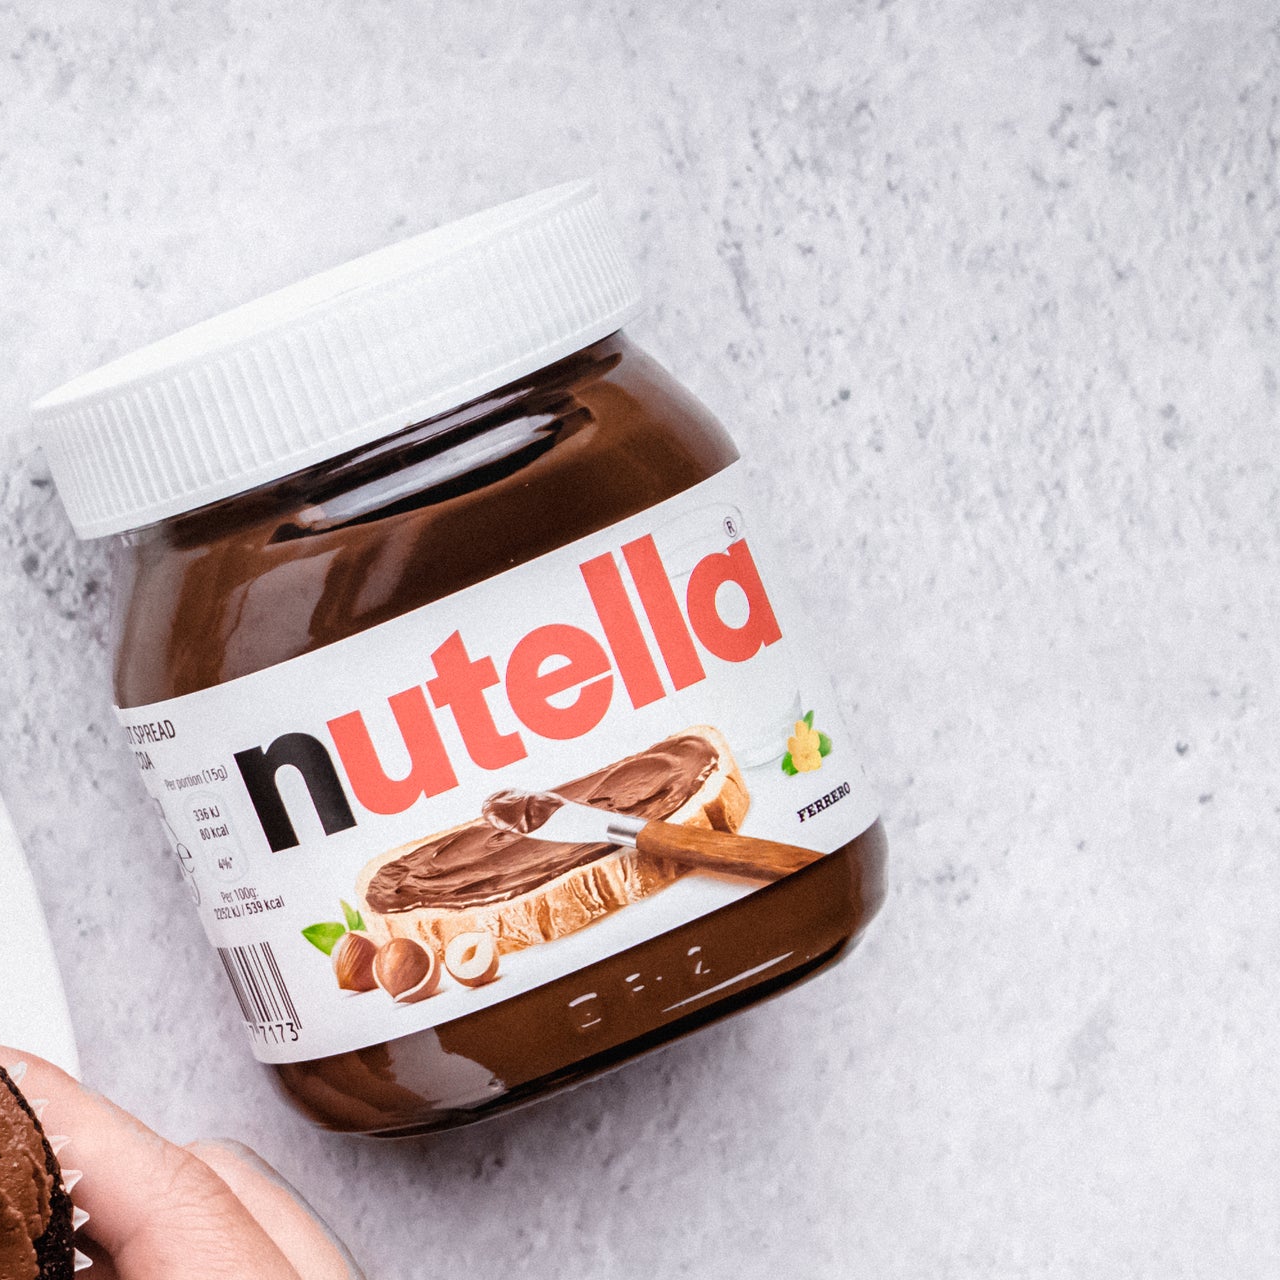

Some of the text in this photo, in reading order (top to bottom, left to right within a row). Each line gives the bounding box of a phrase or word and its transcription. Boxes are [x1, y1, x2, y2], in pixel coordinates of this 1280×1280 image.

[233, 533, 783, 854] nutella
[132, 719, 176, 745] SPREAD
[164, 764, 228, 791] Per portion (15g)
[193, 805, 220, 822] 336 kJ
[796, 781, 851, 823] FERRERO
[200, 823, 230, 841] 80 kcal
[220, 887, 259, 903] Per 100g:
[245, 900, 263, 915] 539
[263, 895, 285, 911] kcal
